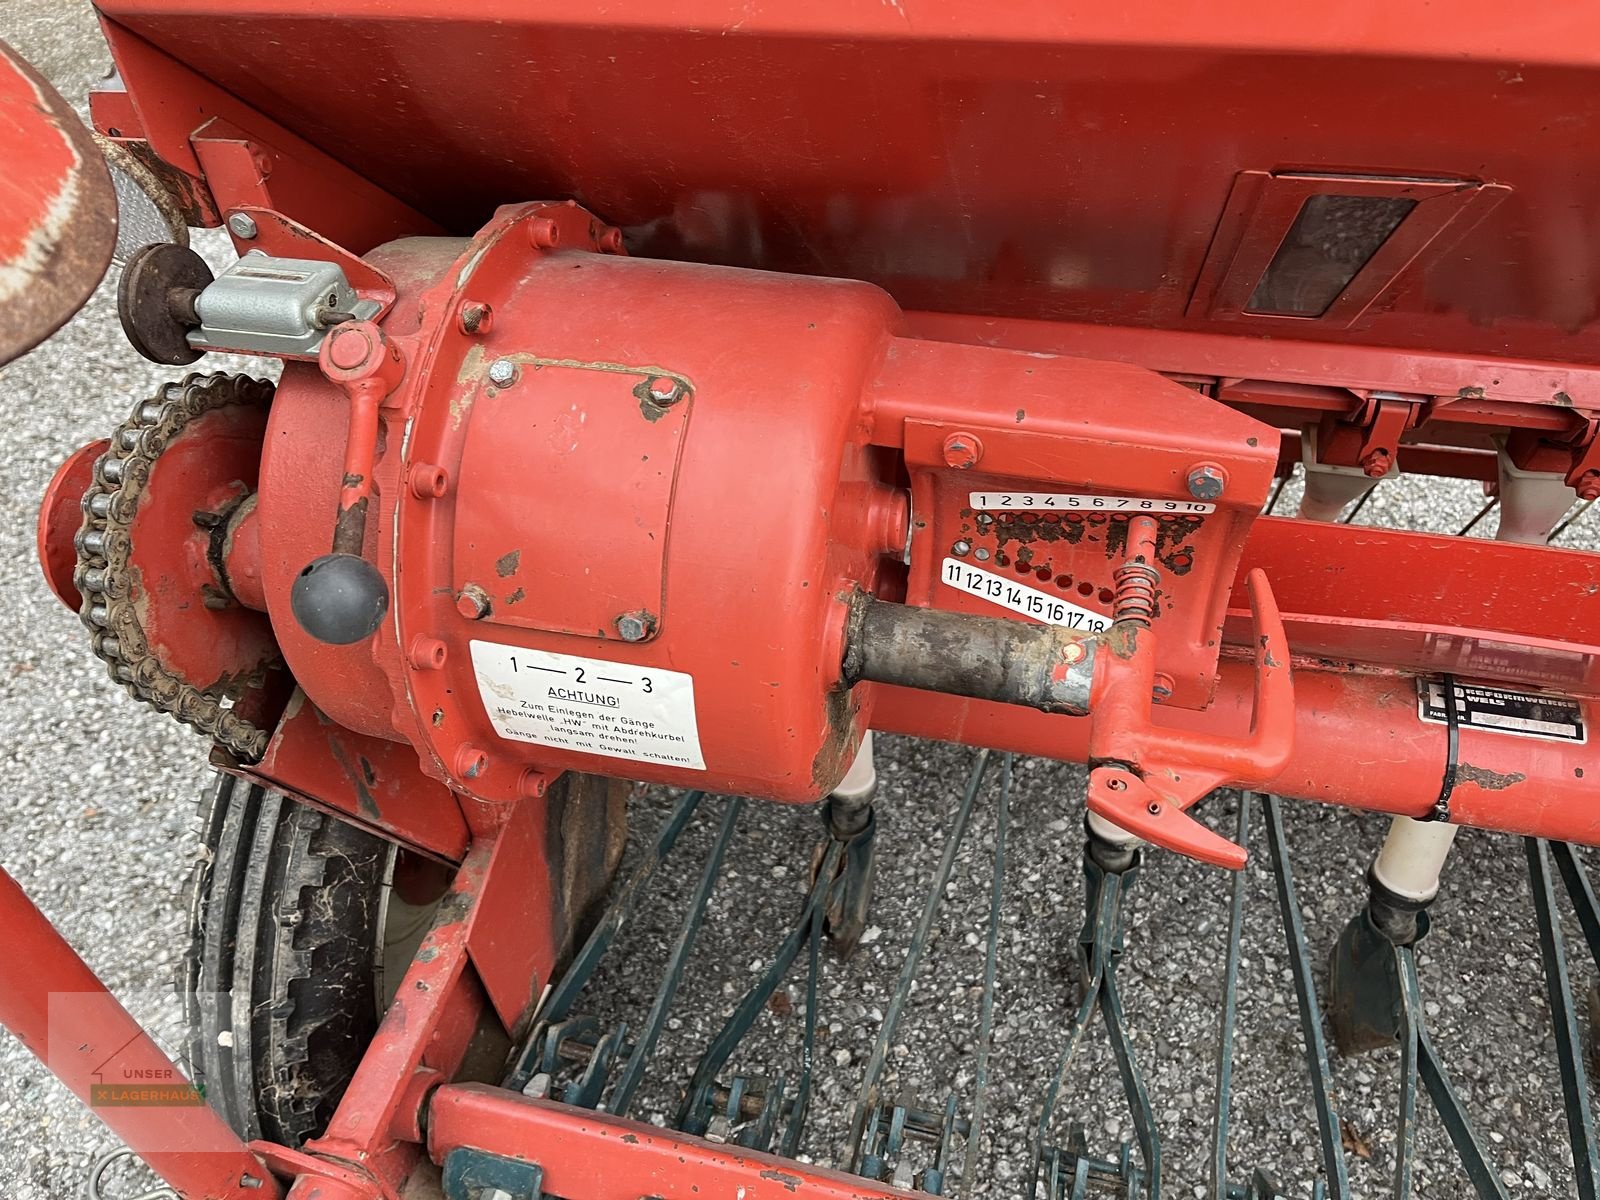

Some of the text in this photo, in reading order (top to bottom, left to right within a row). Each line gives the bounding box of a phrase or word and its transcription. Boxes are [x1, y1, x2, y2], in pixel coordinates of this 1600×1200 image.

[980, 495, 1206, 512] 1 2 3 4 5 6 7 8 9 10
[948, 564, 961, 581] 11
[966, 572, 983, 590] 12
[986, 579, 1002, 597] 13
[1006, 587, 1022, 605] 14
[1026, 595, 1043, 613] 15
[1047, 603, 1064, 621] 16
[1067, 611, 1084, 629] 17
[510, 656, 653, 693] 1 2 3
[547, 686, 620, 707] ACHTUNG!
[497, 706, 555, 722] Hebelwelle
[591, 723, 609, 731] mit
[613, 725, 686, 743] Abdrehkurbel
[520, 700, 655, 729] Zum Einlegen der Gänge
[505, 727, 691, 763] Gänge nicht mit Gewalt schalten!
[550, 724, 638, 744] langsam drehen!
